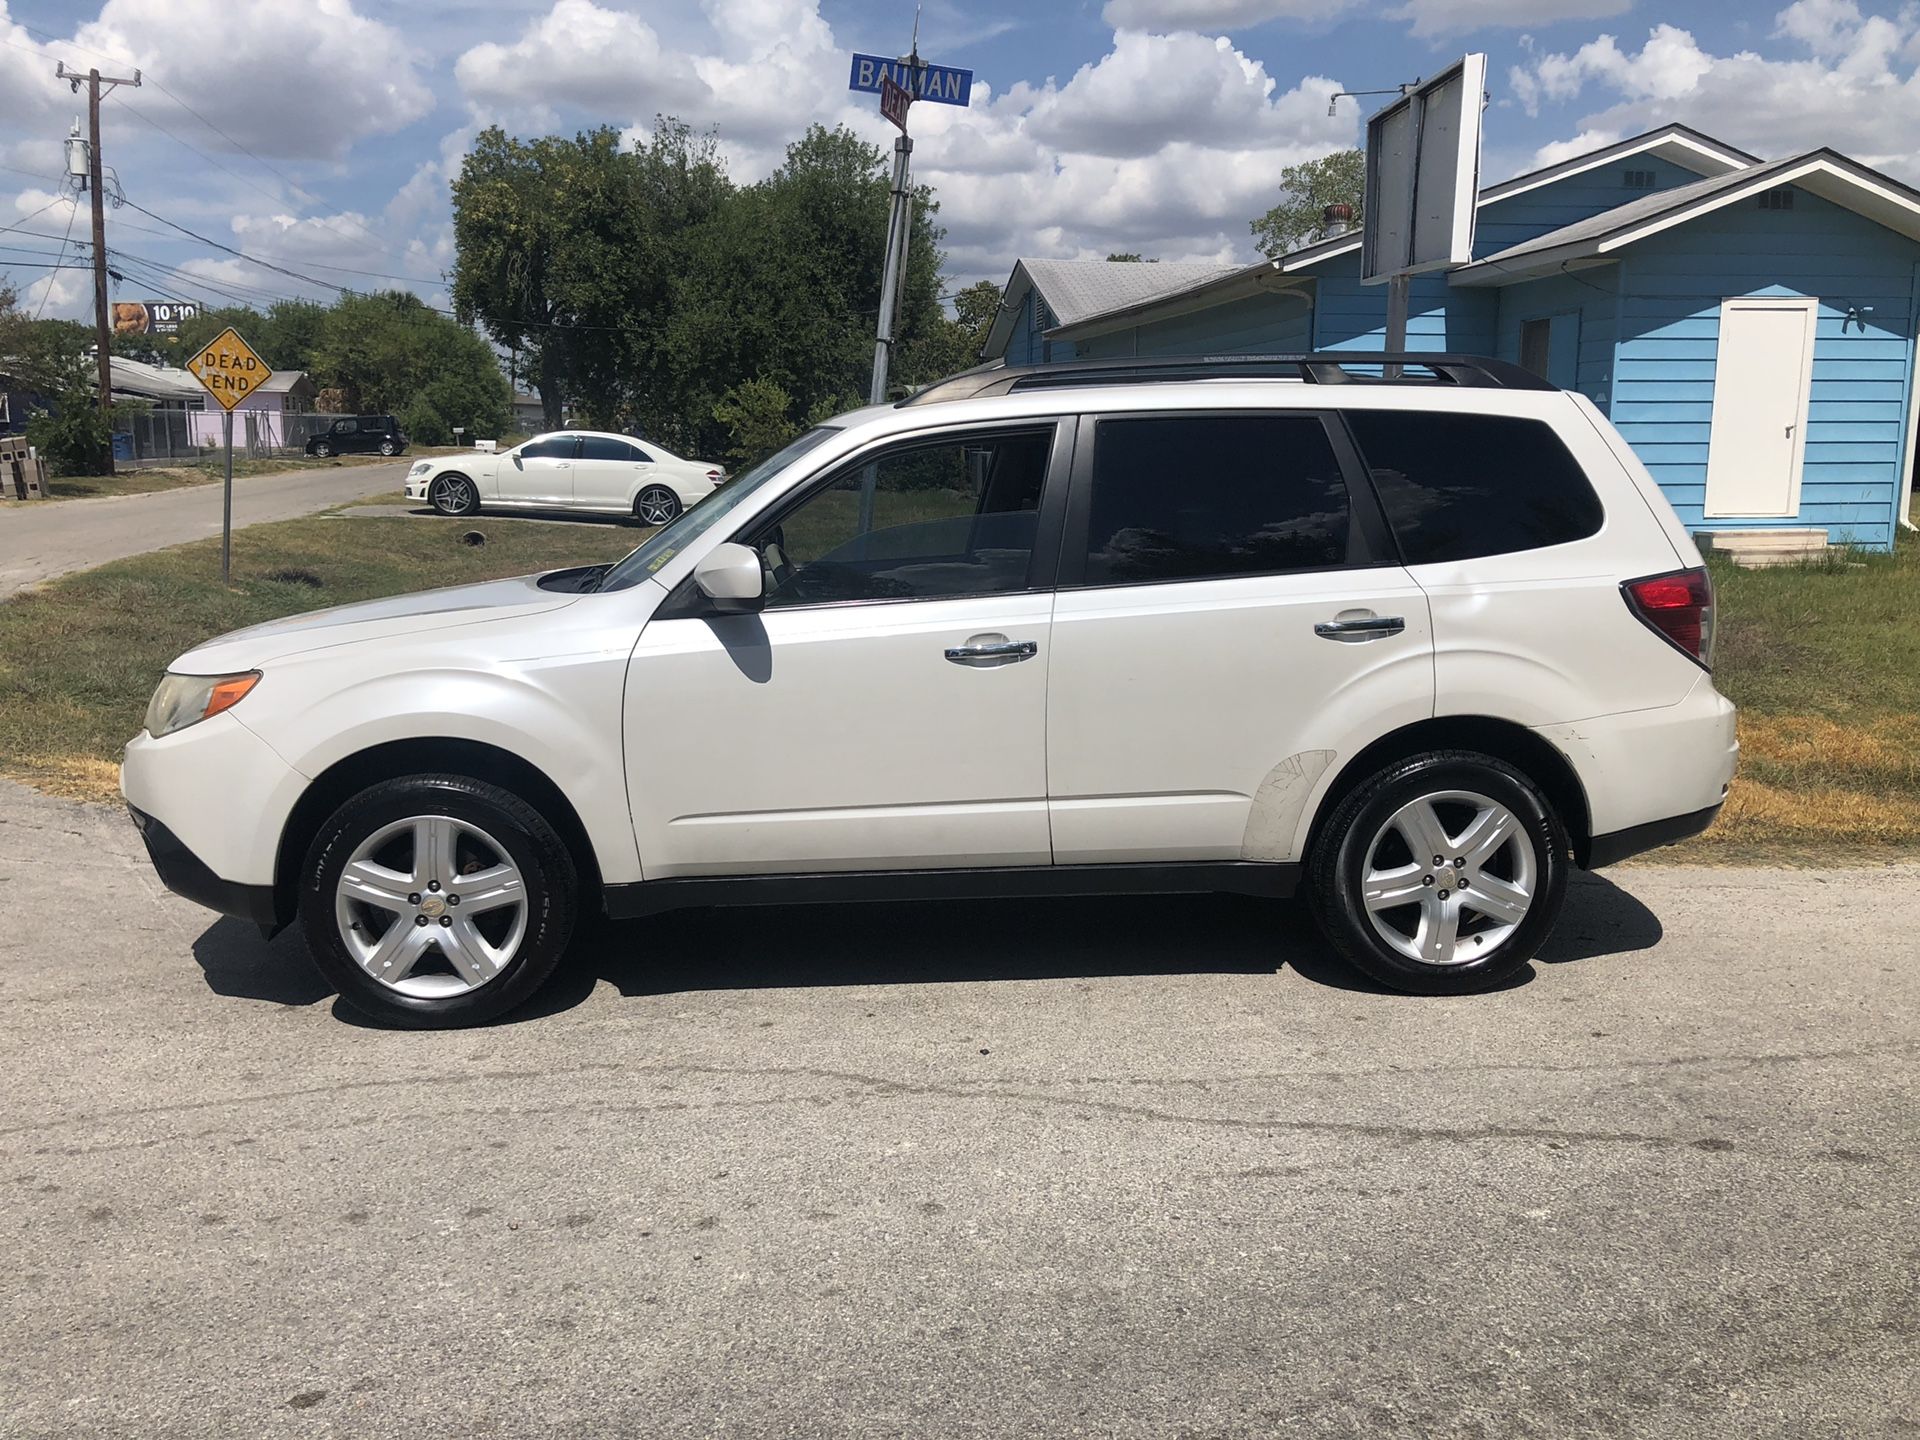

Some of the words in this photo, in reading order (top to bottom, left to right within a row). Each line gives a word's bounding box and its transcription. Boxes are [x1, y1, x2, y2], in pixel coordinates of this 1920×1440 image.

[858, 60, 961, 100] BAUMAN
[153, 305, 170, 320] 10
[173, 305, 195, 320] $10
[205, 353, 257, 371] DEAD
[212, 374, 249, 391] END
